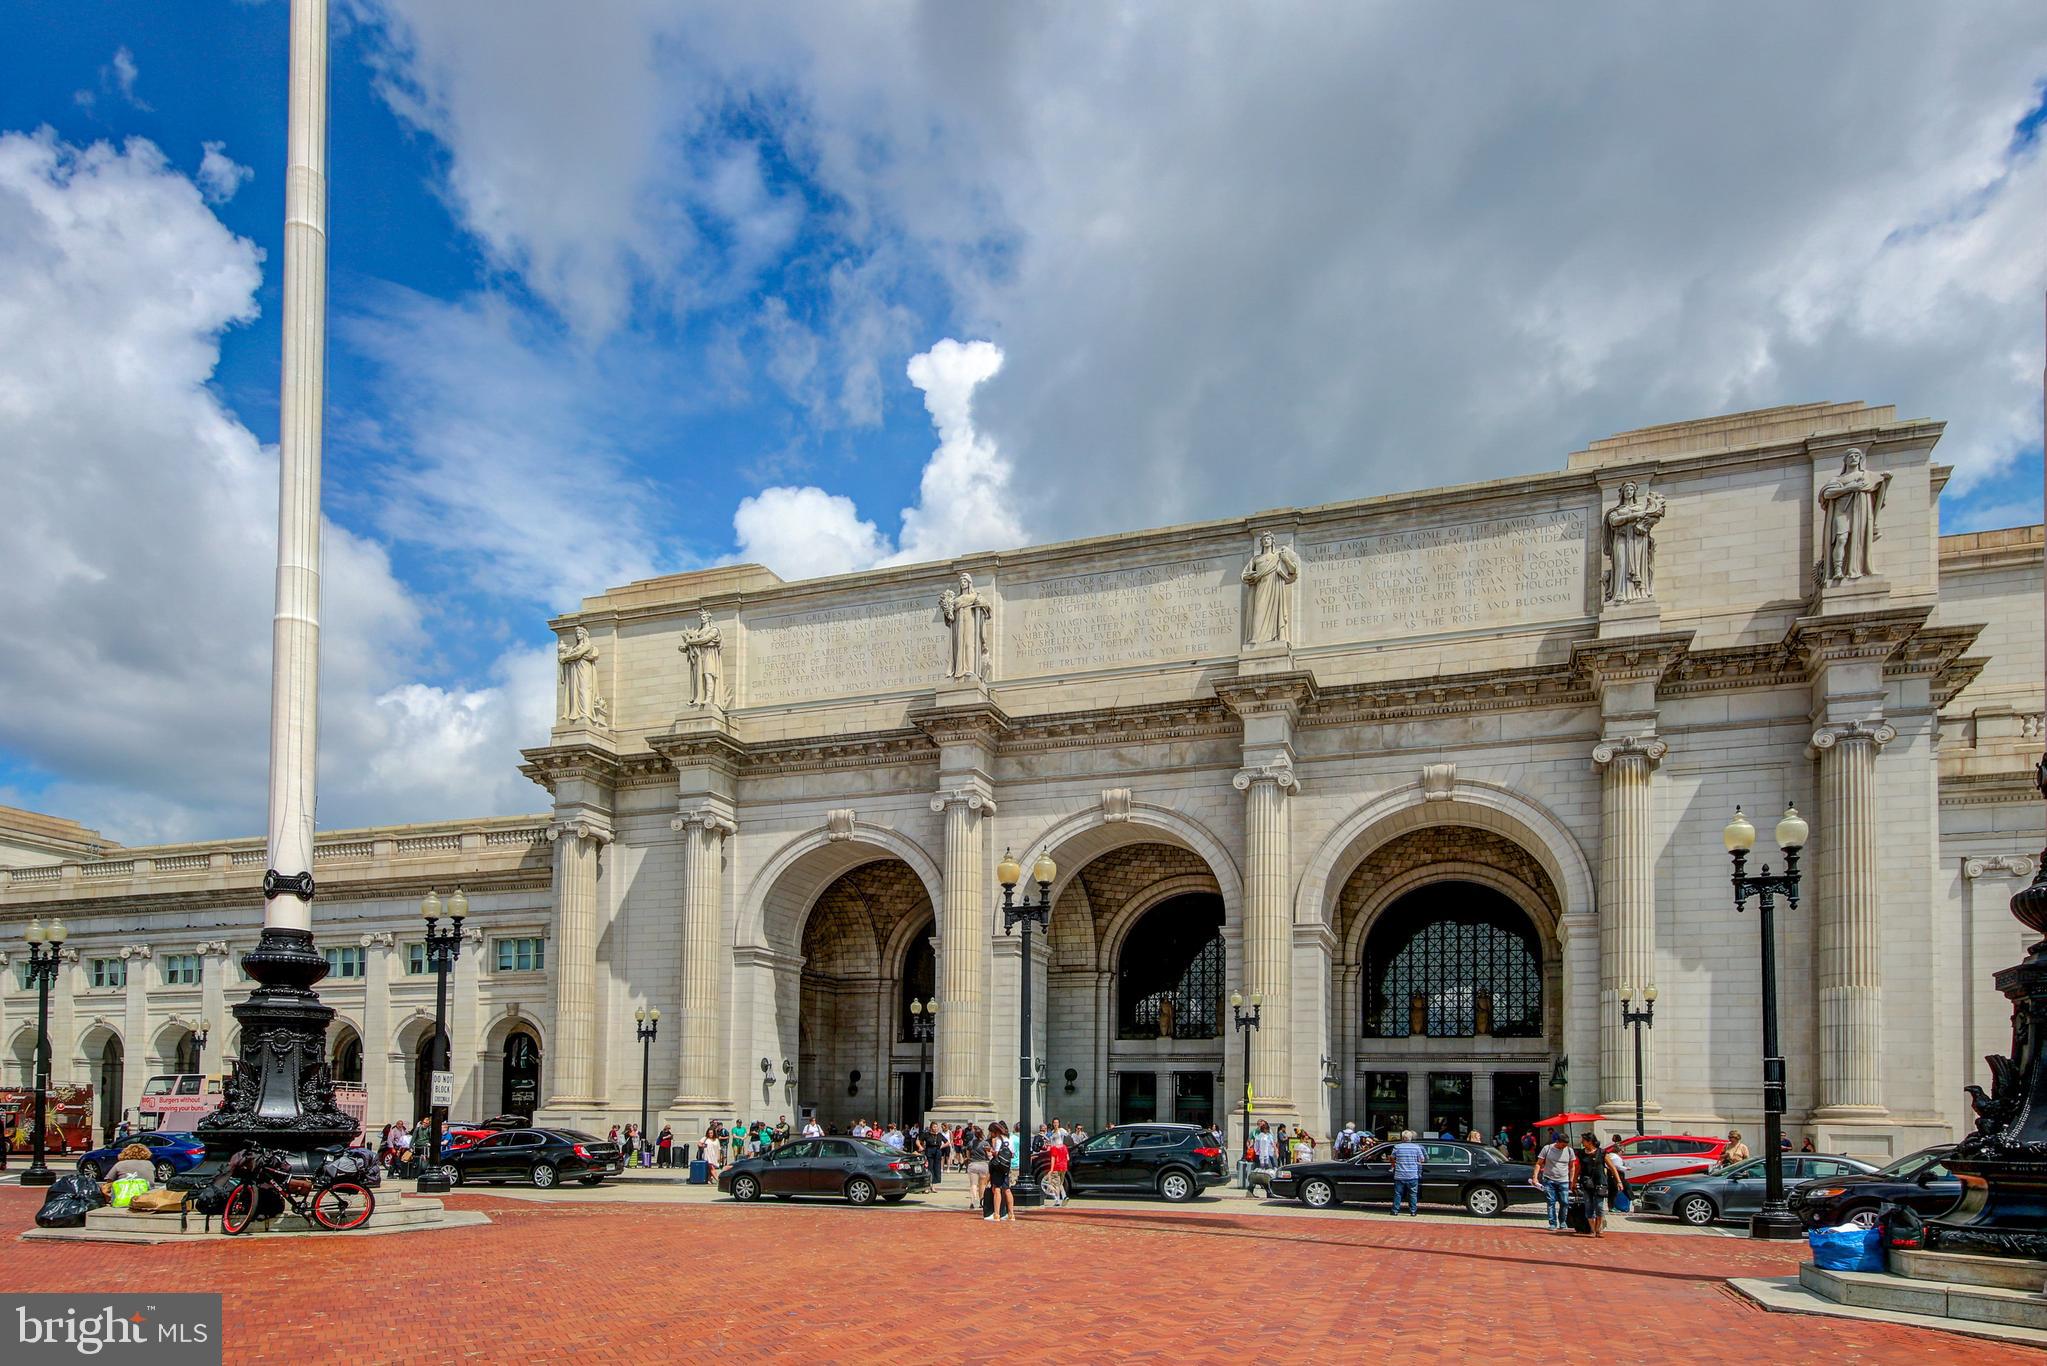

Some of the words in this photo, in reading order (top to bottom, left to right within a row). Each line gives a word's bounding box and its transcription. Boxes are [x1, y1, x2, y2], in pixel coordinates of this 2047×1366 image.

[1312, 578, 1332, 589] THE
[1339, 574, 1359, 585] OLD
[1367, 566, 1422, 582] MECHANIC
[1432, 562, 1457, 573] ARTS
[1468, 550, 1548, 569] CONTROLLING
[1555, 546, 1580, 558] NEW
[1315, 596, 1336, 606] AND
[1376, 584, 1429, 599] OVERRIDE
[1437, 581, 1457, 591] THE
[1464, 575, 1504, 588] OCEAN
[1516, 570, 1539, 581] AND
[1545, 565, 1580, 578] MAKE
[1320, 584, 1360, 596] FORCES
[1408, 575, 1428, 585] NEW
[1437, 567, 1493, 582] HIGHWAYS
[1501, 563, 1521, 574] FOR
[1530, 557, 1571, 570] GOODS
[1321, 604, 1340, 615] THE
[1346, 600, 1374, 612] VERY
[1421, 590, 1457, 603] CARRY
[1514, 576, 1569, 591] THOUGHT
[1321, 620, 1339, 630] THE
[1346, 614, 1385, 627] DESERT
[1392, 609, 1427, 622] SHALL
[1434, 602, 1480, 617] REJOICE
[1487, 599, 1510, 610] AND
[1516, 591, 1572, 607] BLOSSOM
[1404, 620, 1416, 630] AS
[1425, 617, 1444, 628] THE
[1452, 613, 1480, 625] ROSE
[434, 1075, 441, 1083] DO
[435, 1085, 450, 1093] BLOCK
